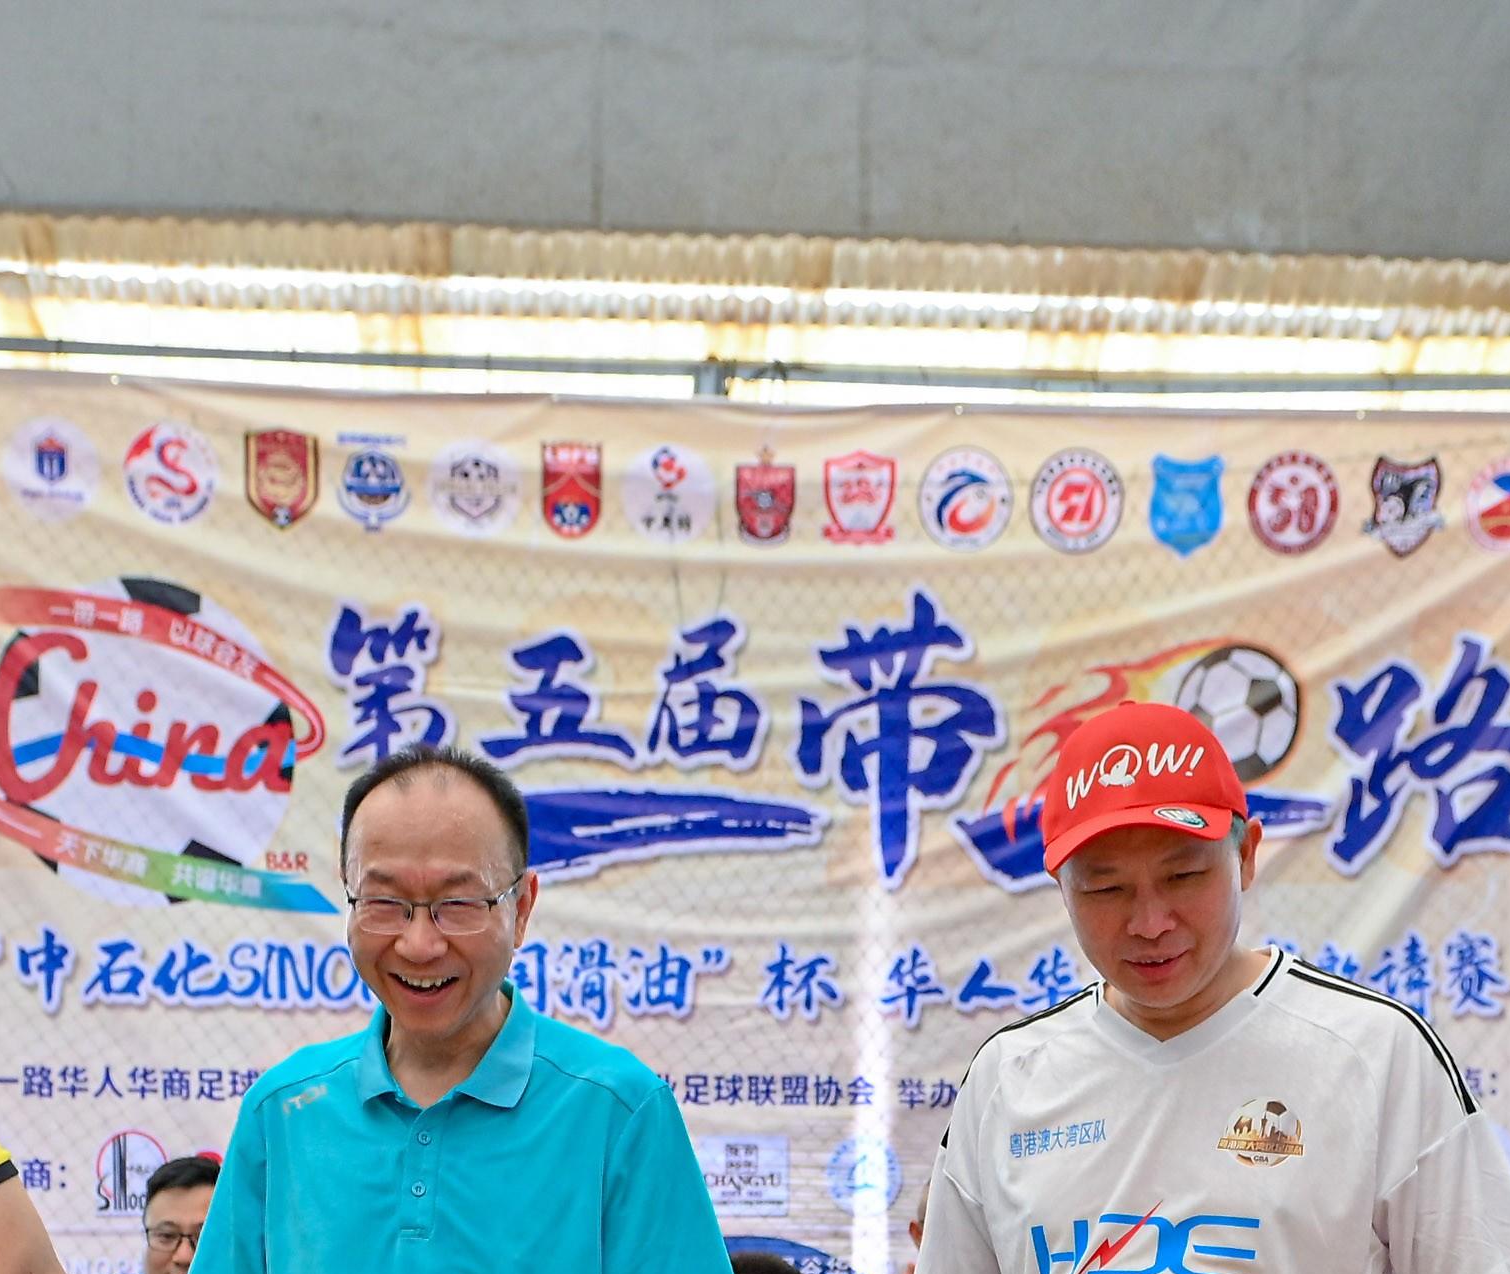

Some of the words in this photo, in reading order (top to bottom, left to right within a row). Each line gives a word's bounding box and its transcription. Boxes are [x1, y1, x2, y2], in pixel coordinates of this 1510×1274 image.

[1009, 1118, 1108, 1159] 粤港澳大湾区队
